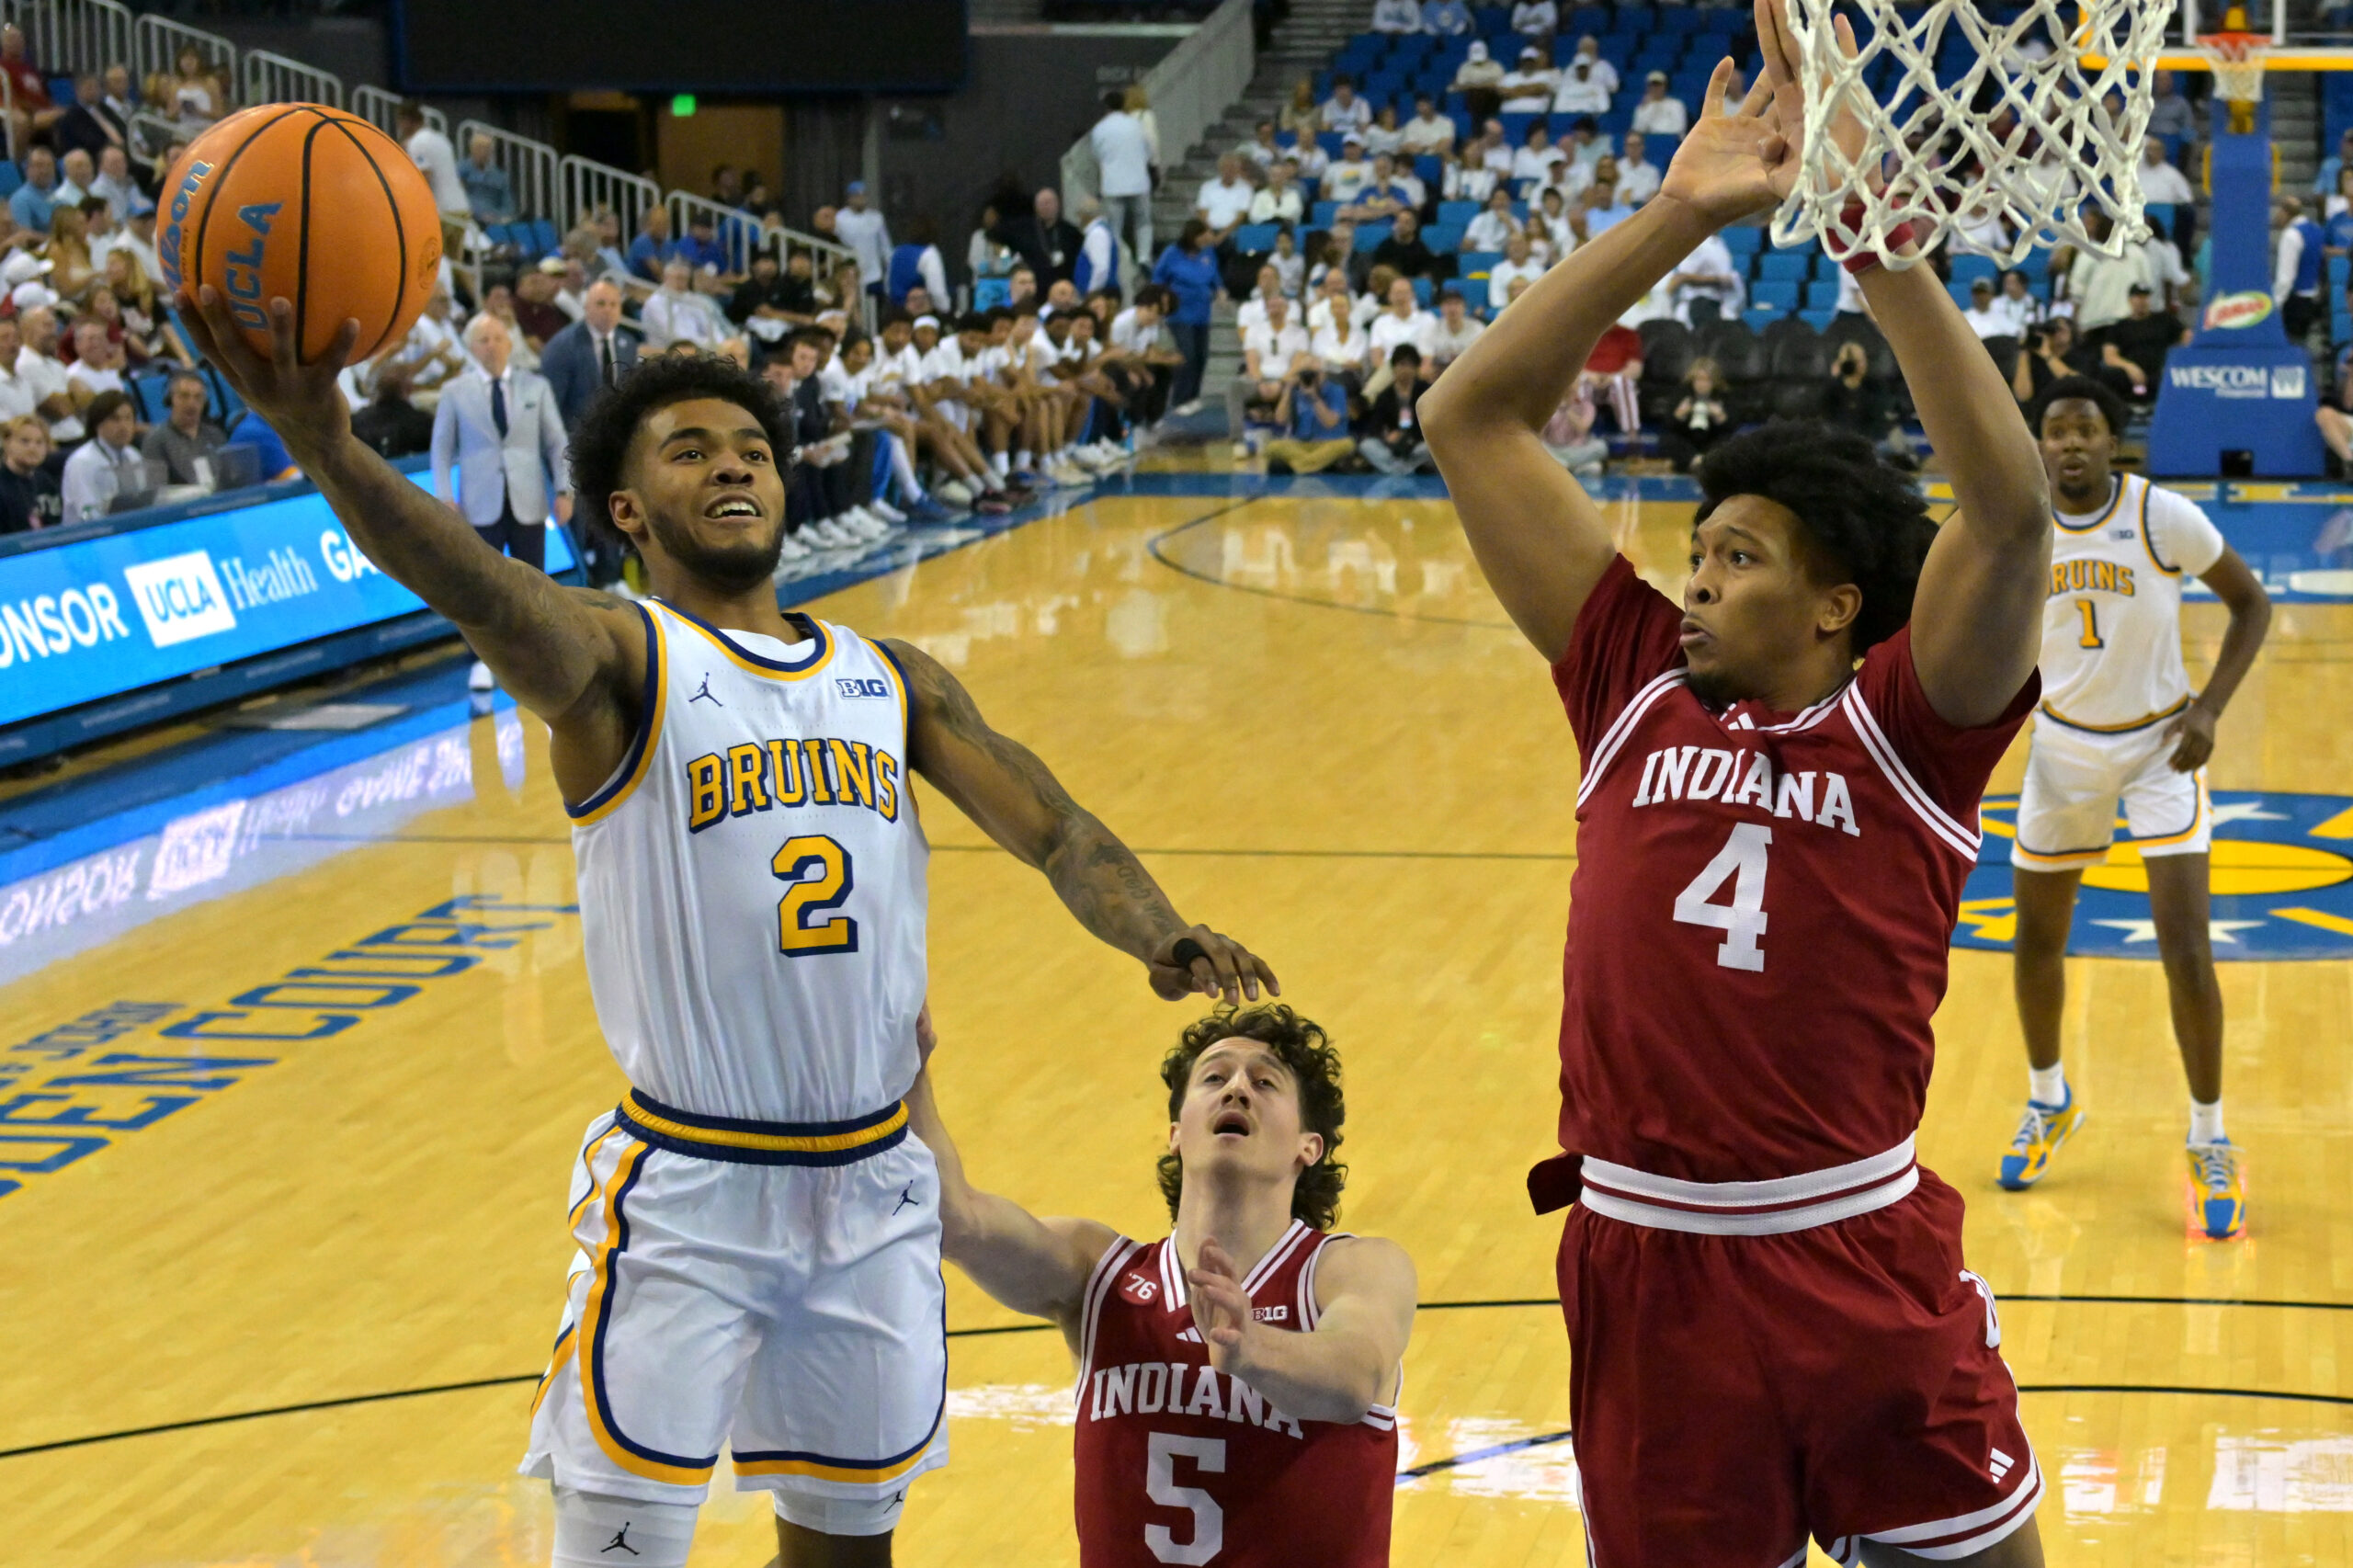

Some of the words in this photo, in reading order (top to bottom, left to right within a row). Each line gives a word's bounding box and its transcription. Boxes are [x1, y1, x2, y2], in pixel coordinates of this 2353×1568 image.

[225, 200, 284, 331] UCLA
[2170, 365, 2268, 388] WESCOM
[144, 574, 217, 621] UCLA
[221, 546, 319, 610] Health
[320, 529, 380, 583] GA
[2047, 559, 2134, 597] RUINS
[2075, 599, 2105, 649] 1
[687, 738, 898, 834] BRUINS
[1632, 745, 1860, 837] INDIANA
[771, 834, 858, 958] 2
[1673, 822, 1772, 972] 4
[1144, 1431, 1226, 1566] 5
